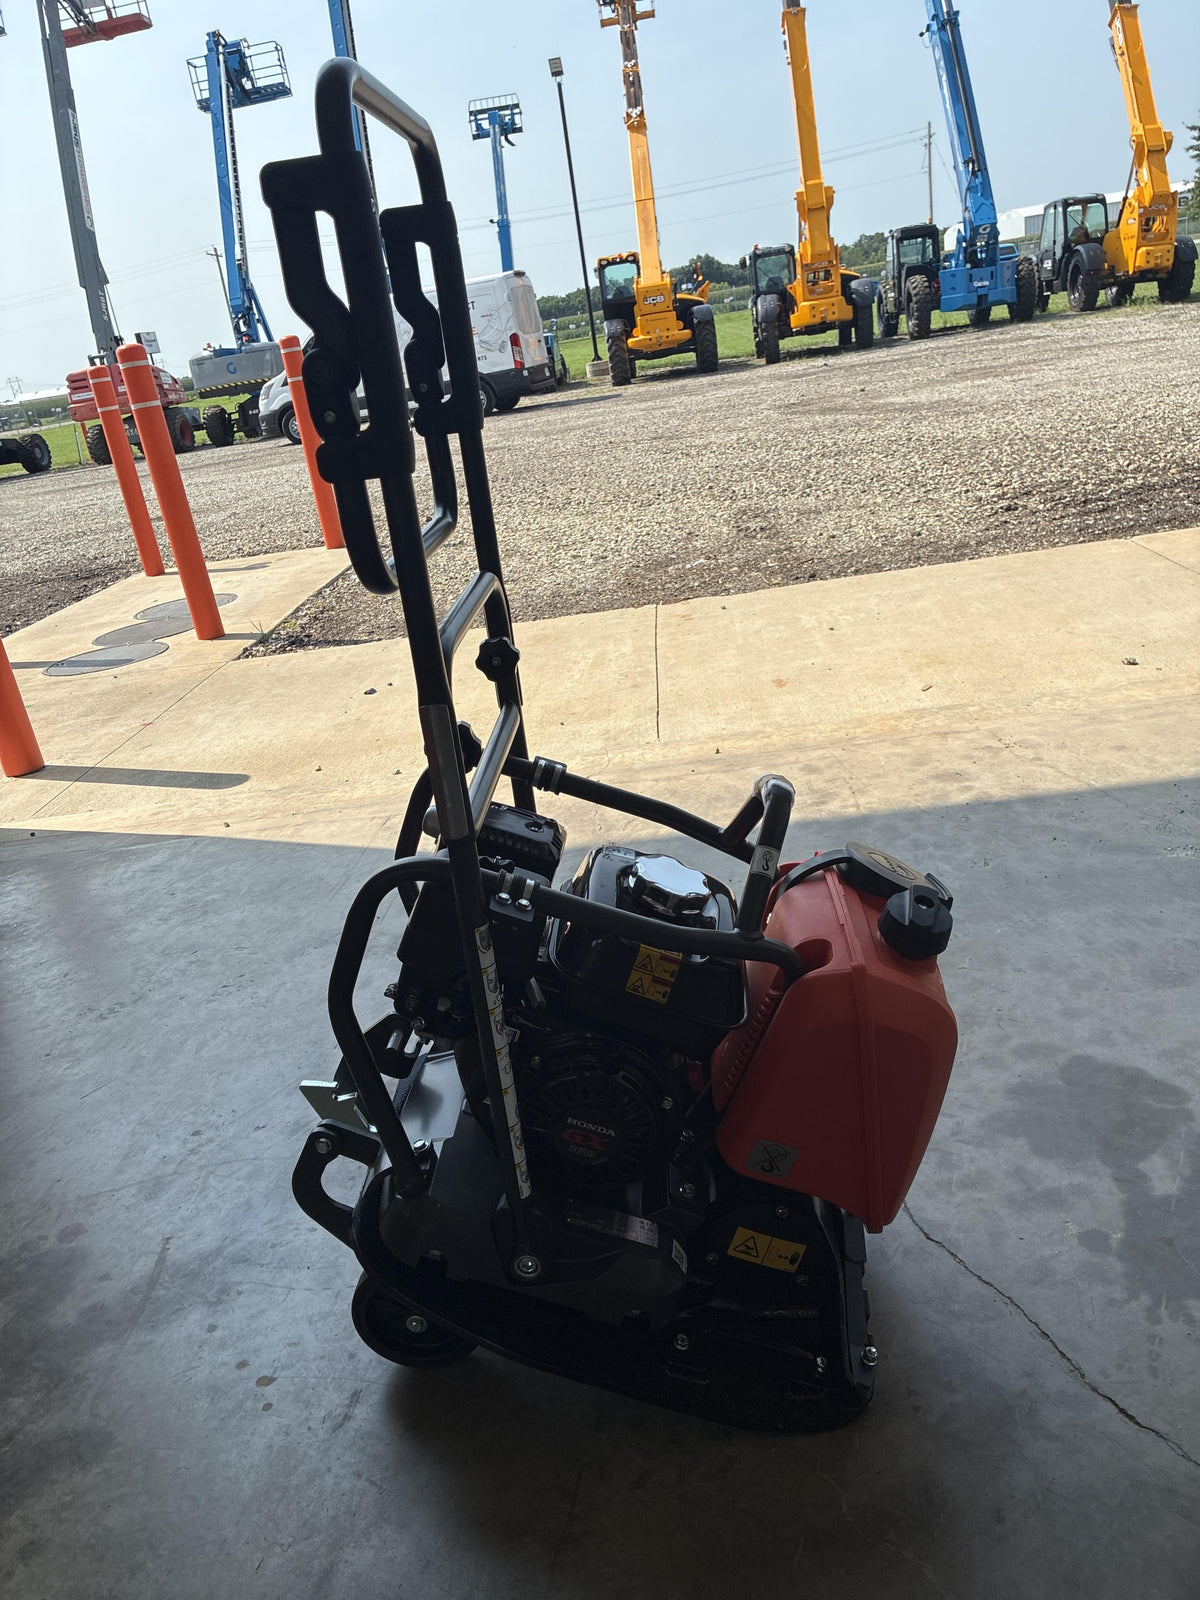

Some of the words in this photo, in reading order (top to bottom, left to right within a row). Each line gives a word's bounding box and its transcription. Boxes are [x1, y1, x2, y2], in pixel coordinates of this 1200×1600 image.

[643, 294, 665, 305] JCB
[565, 1116, 617, 1138] HONDA
[561, 1127, 610, 1152] GX
